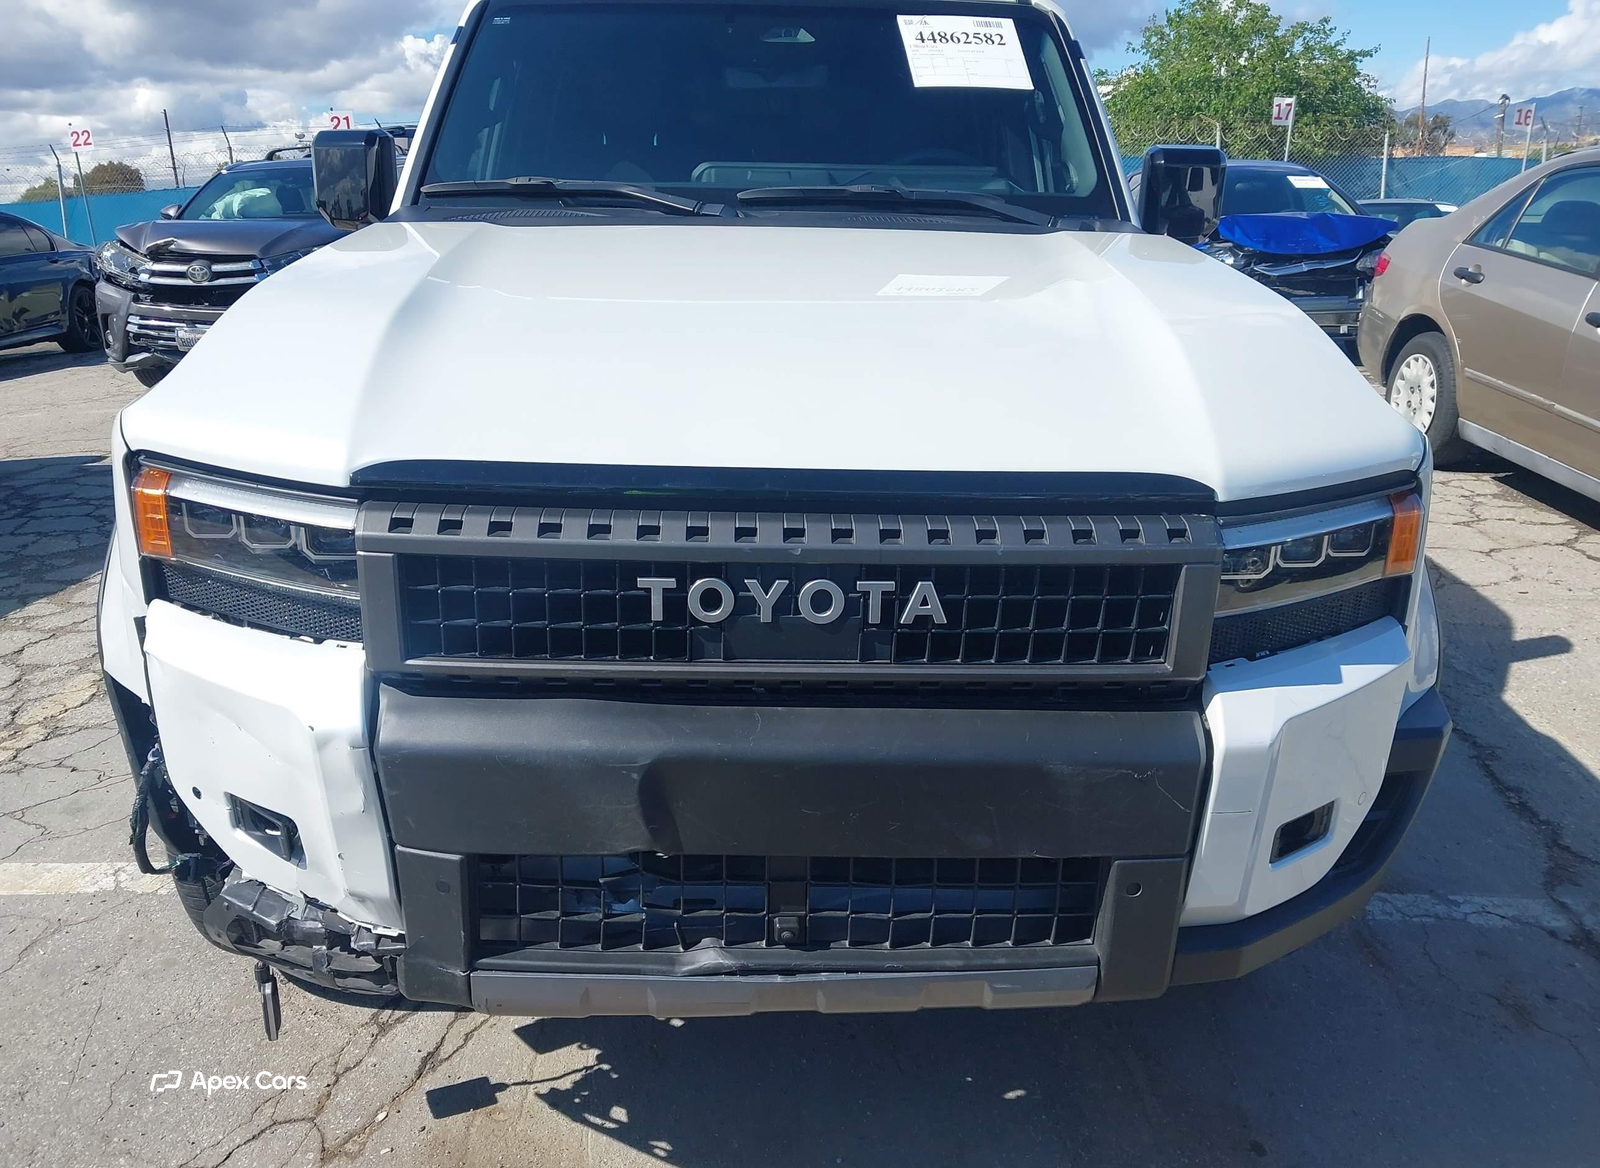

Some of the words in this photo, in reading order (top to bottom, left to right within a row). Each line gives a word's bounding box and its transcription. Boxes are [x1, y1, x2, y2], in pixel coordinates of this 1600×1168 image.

[915, 30, 1006, 46] 44862582
[1274, 102, 1293, 121] 17
[1514, 108, 1533, 127] 16
[330, 115, 351, 130] 21
[70, 129, 93, 147] 22
[636, 576, 948, 625] TOYOTA
